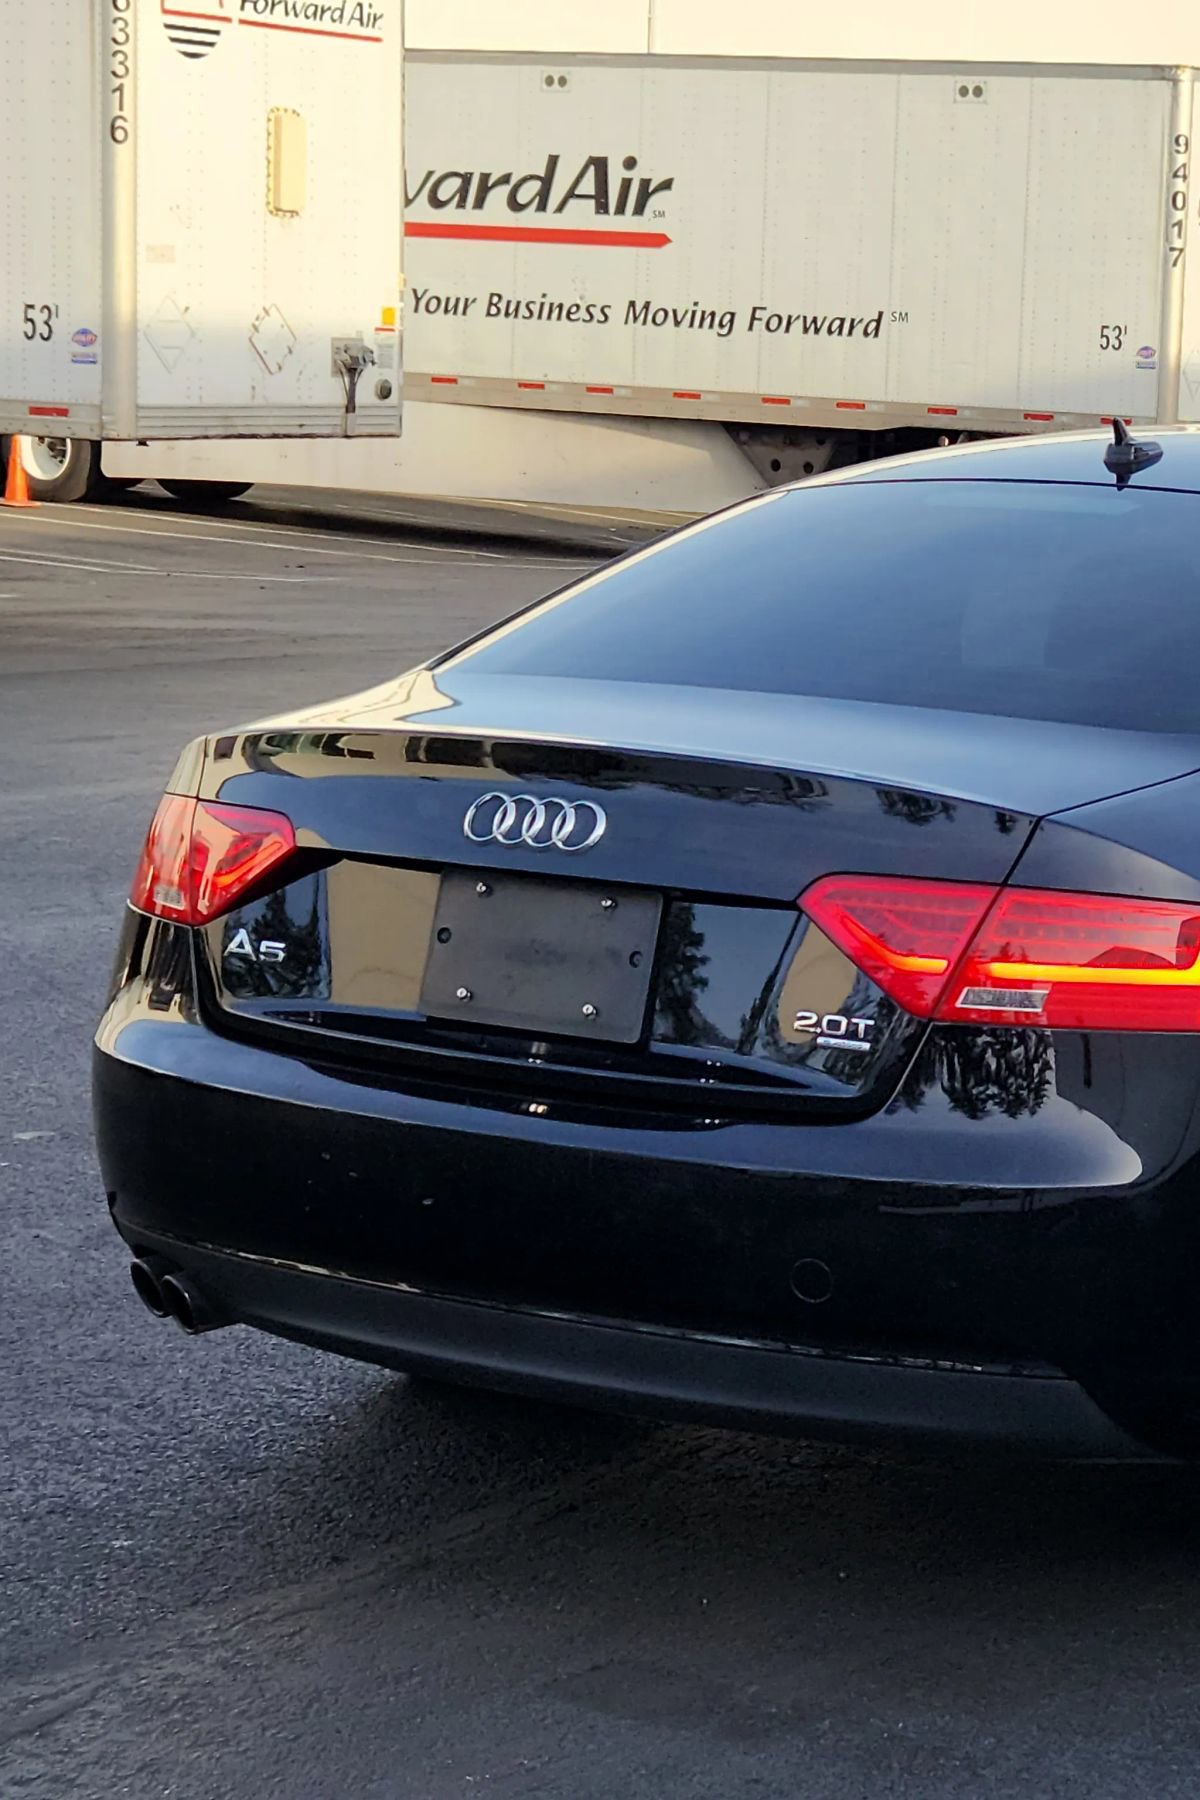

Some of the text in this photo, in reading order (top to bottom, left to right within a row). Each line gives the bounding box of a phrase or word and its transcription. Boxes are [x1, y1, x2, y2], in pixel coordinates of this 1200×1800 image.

[347, 2, 383, 29] Air
[552, 155, 675, 217] Air
[1168, 134, 1189, 268] 94017
[23, 303, 59, 342] 53'
[411, 287, 477, 317] Your
[485, 292, 612, 325] Business
[624, 300, 736, 337] Moving
[747, 306, 884, 338] Forward
[1099, 325, 1127, 351] 53'
[223, 927, 287, 963] A5
[793, 1011, 876, 1039] 2.0T
